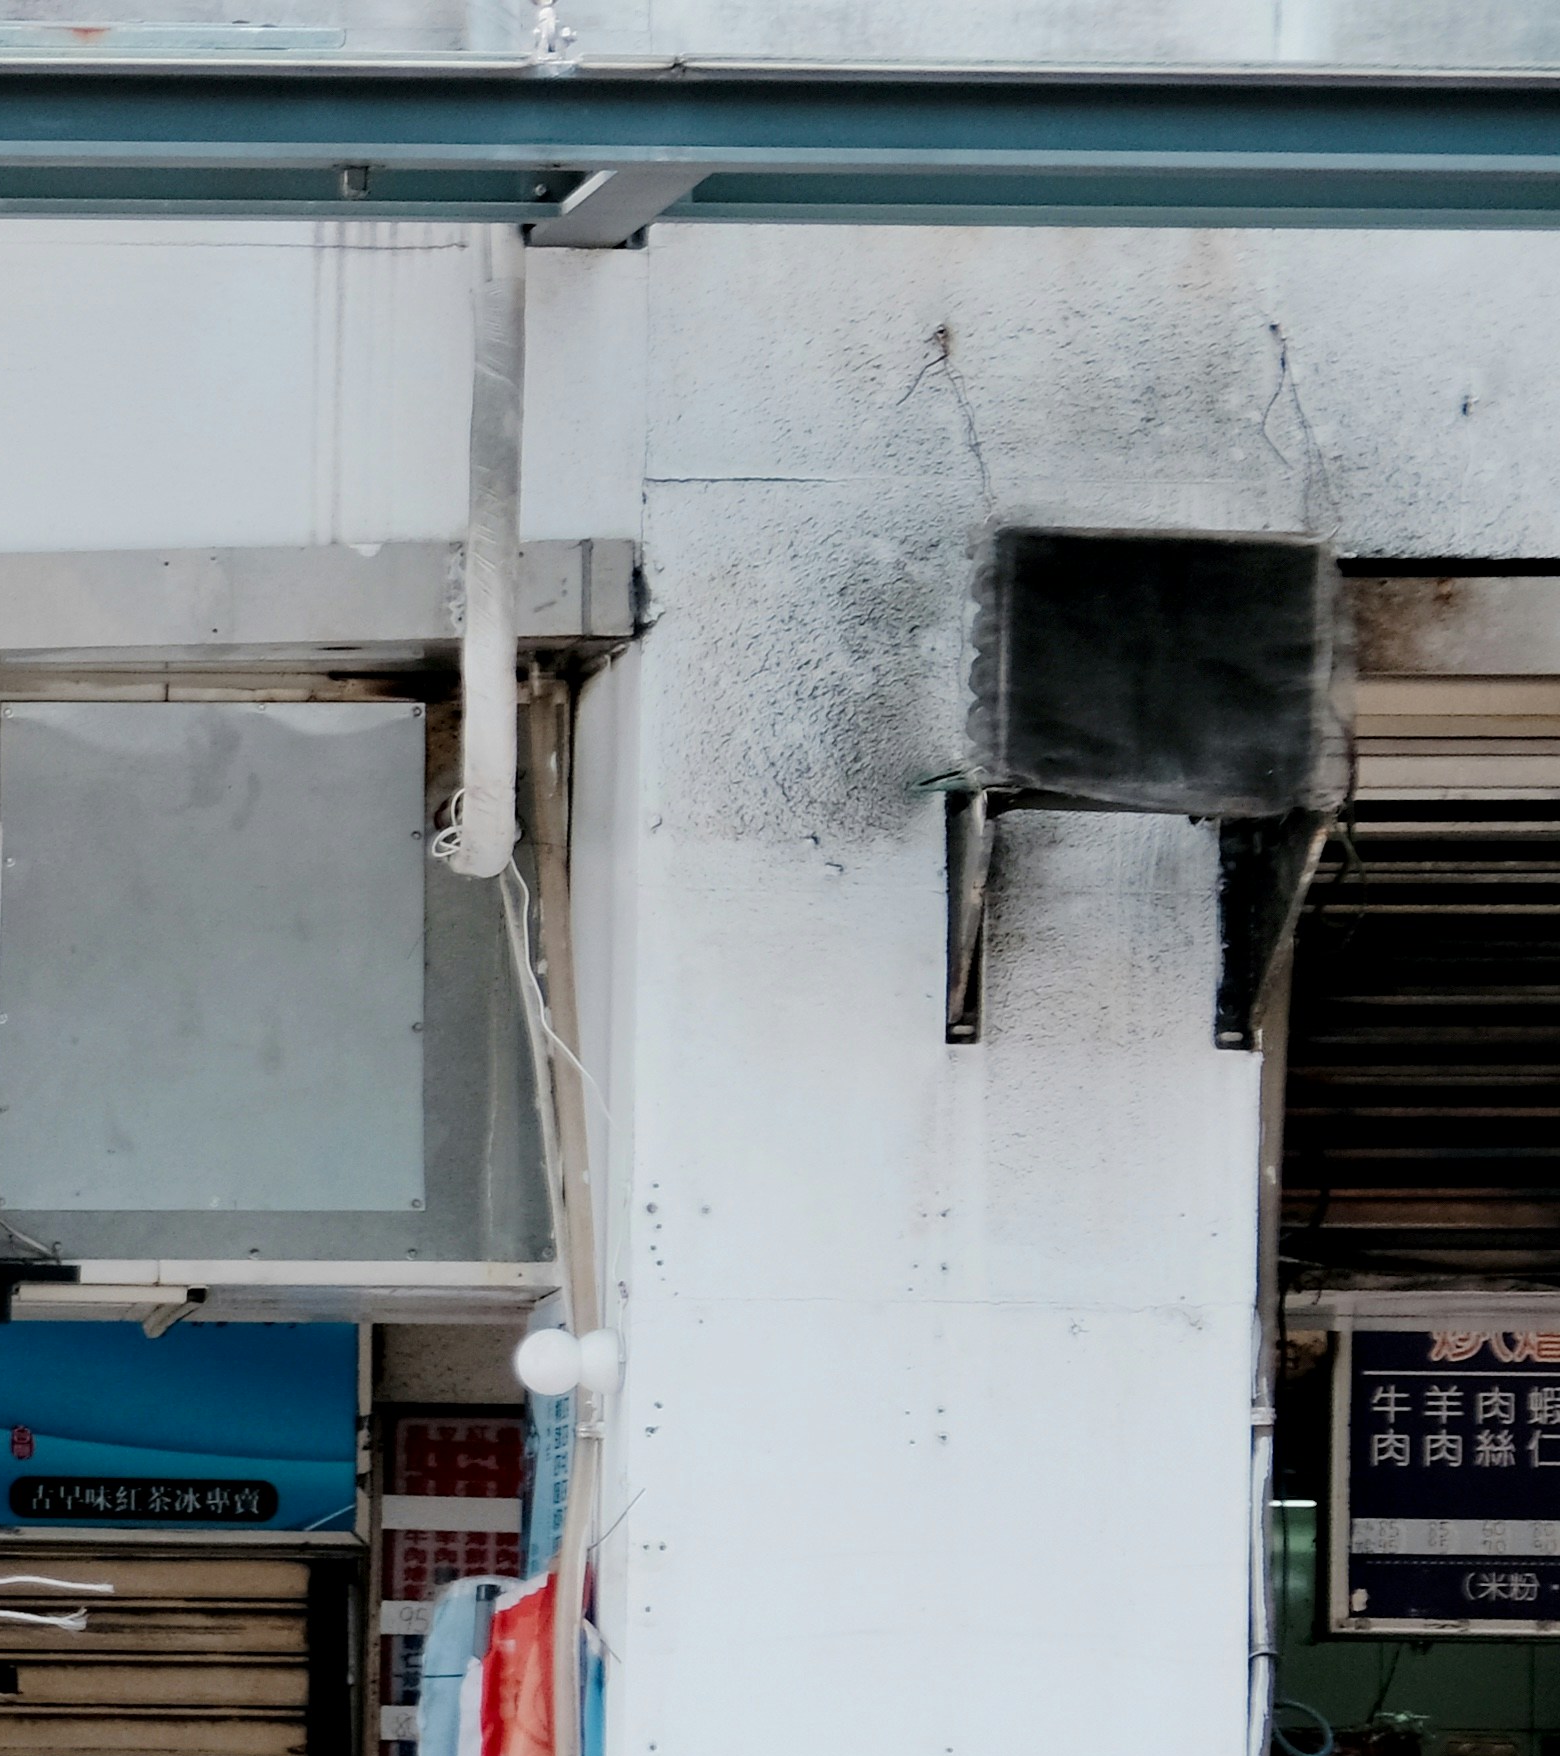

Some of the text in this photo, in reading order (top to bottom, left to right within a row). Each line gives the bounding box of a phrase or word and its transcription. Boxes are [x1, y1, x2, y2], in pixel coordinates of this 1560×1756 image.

[1372, 1385, 1412, 1467] 牛肉
[1423, 1386, 1465, 1468] 羊肉
[1475, 1387, 1517, 1468] 肉絲
[31, 1485, 260, 1516] 古早味紅茶冰專賣
